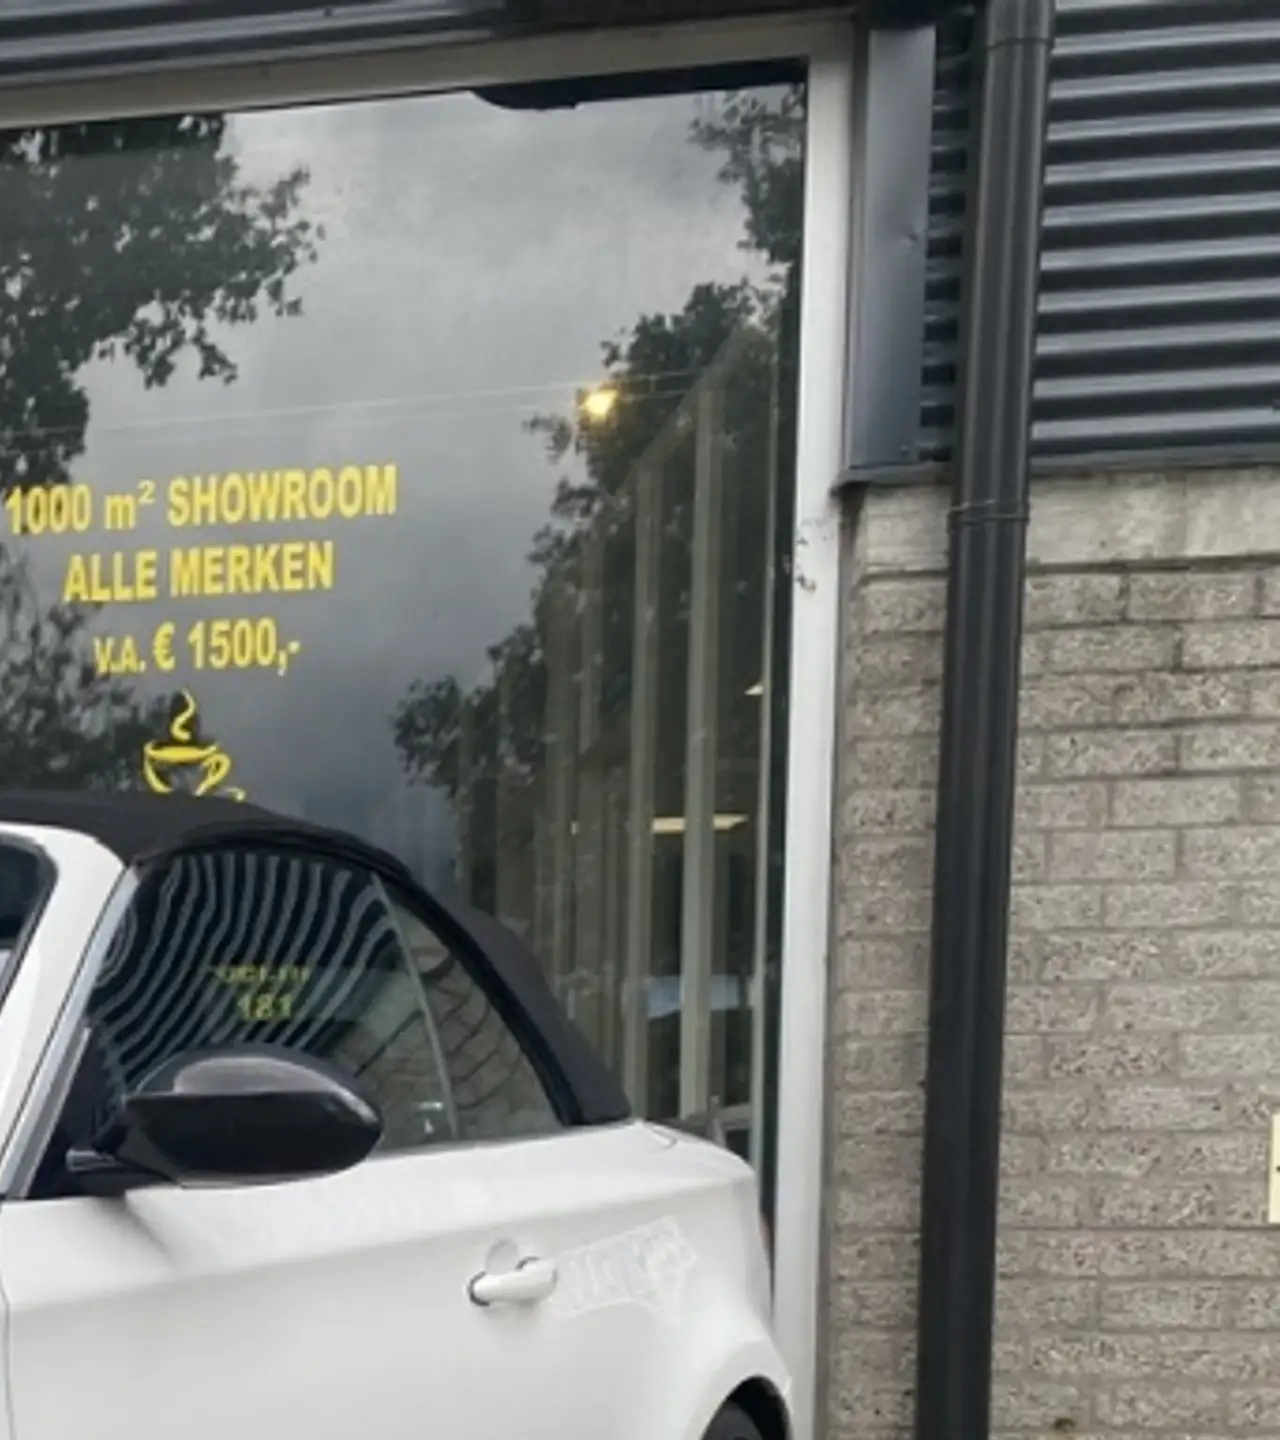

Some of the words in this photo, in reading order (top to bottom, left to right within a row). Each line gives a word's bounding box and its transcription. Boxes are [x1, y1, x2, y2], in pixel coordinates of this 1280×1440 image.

[5, 483, 92, 535] 1000
[167, 464, 398, 528] SHOWROOM
[63, 550, 157, 603] ALLE
[170, 540, 334, 597] MERKEN
[152, 620, 176, 672] €
[187, 616, 301, 677] 1500,-
